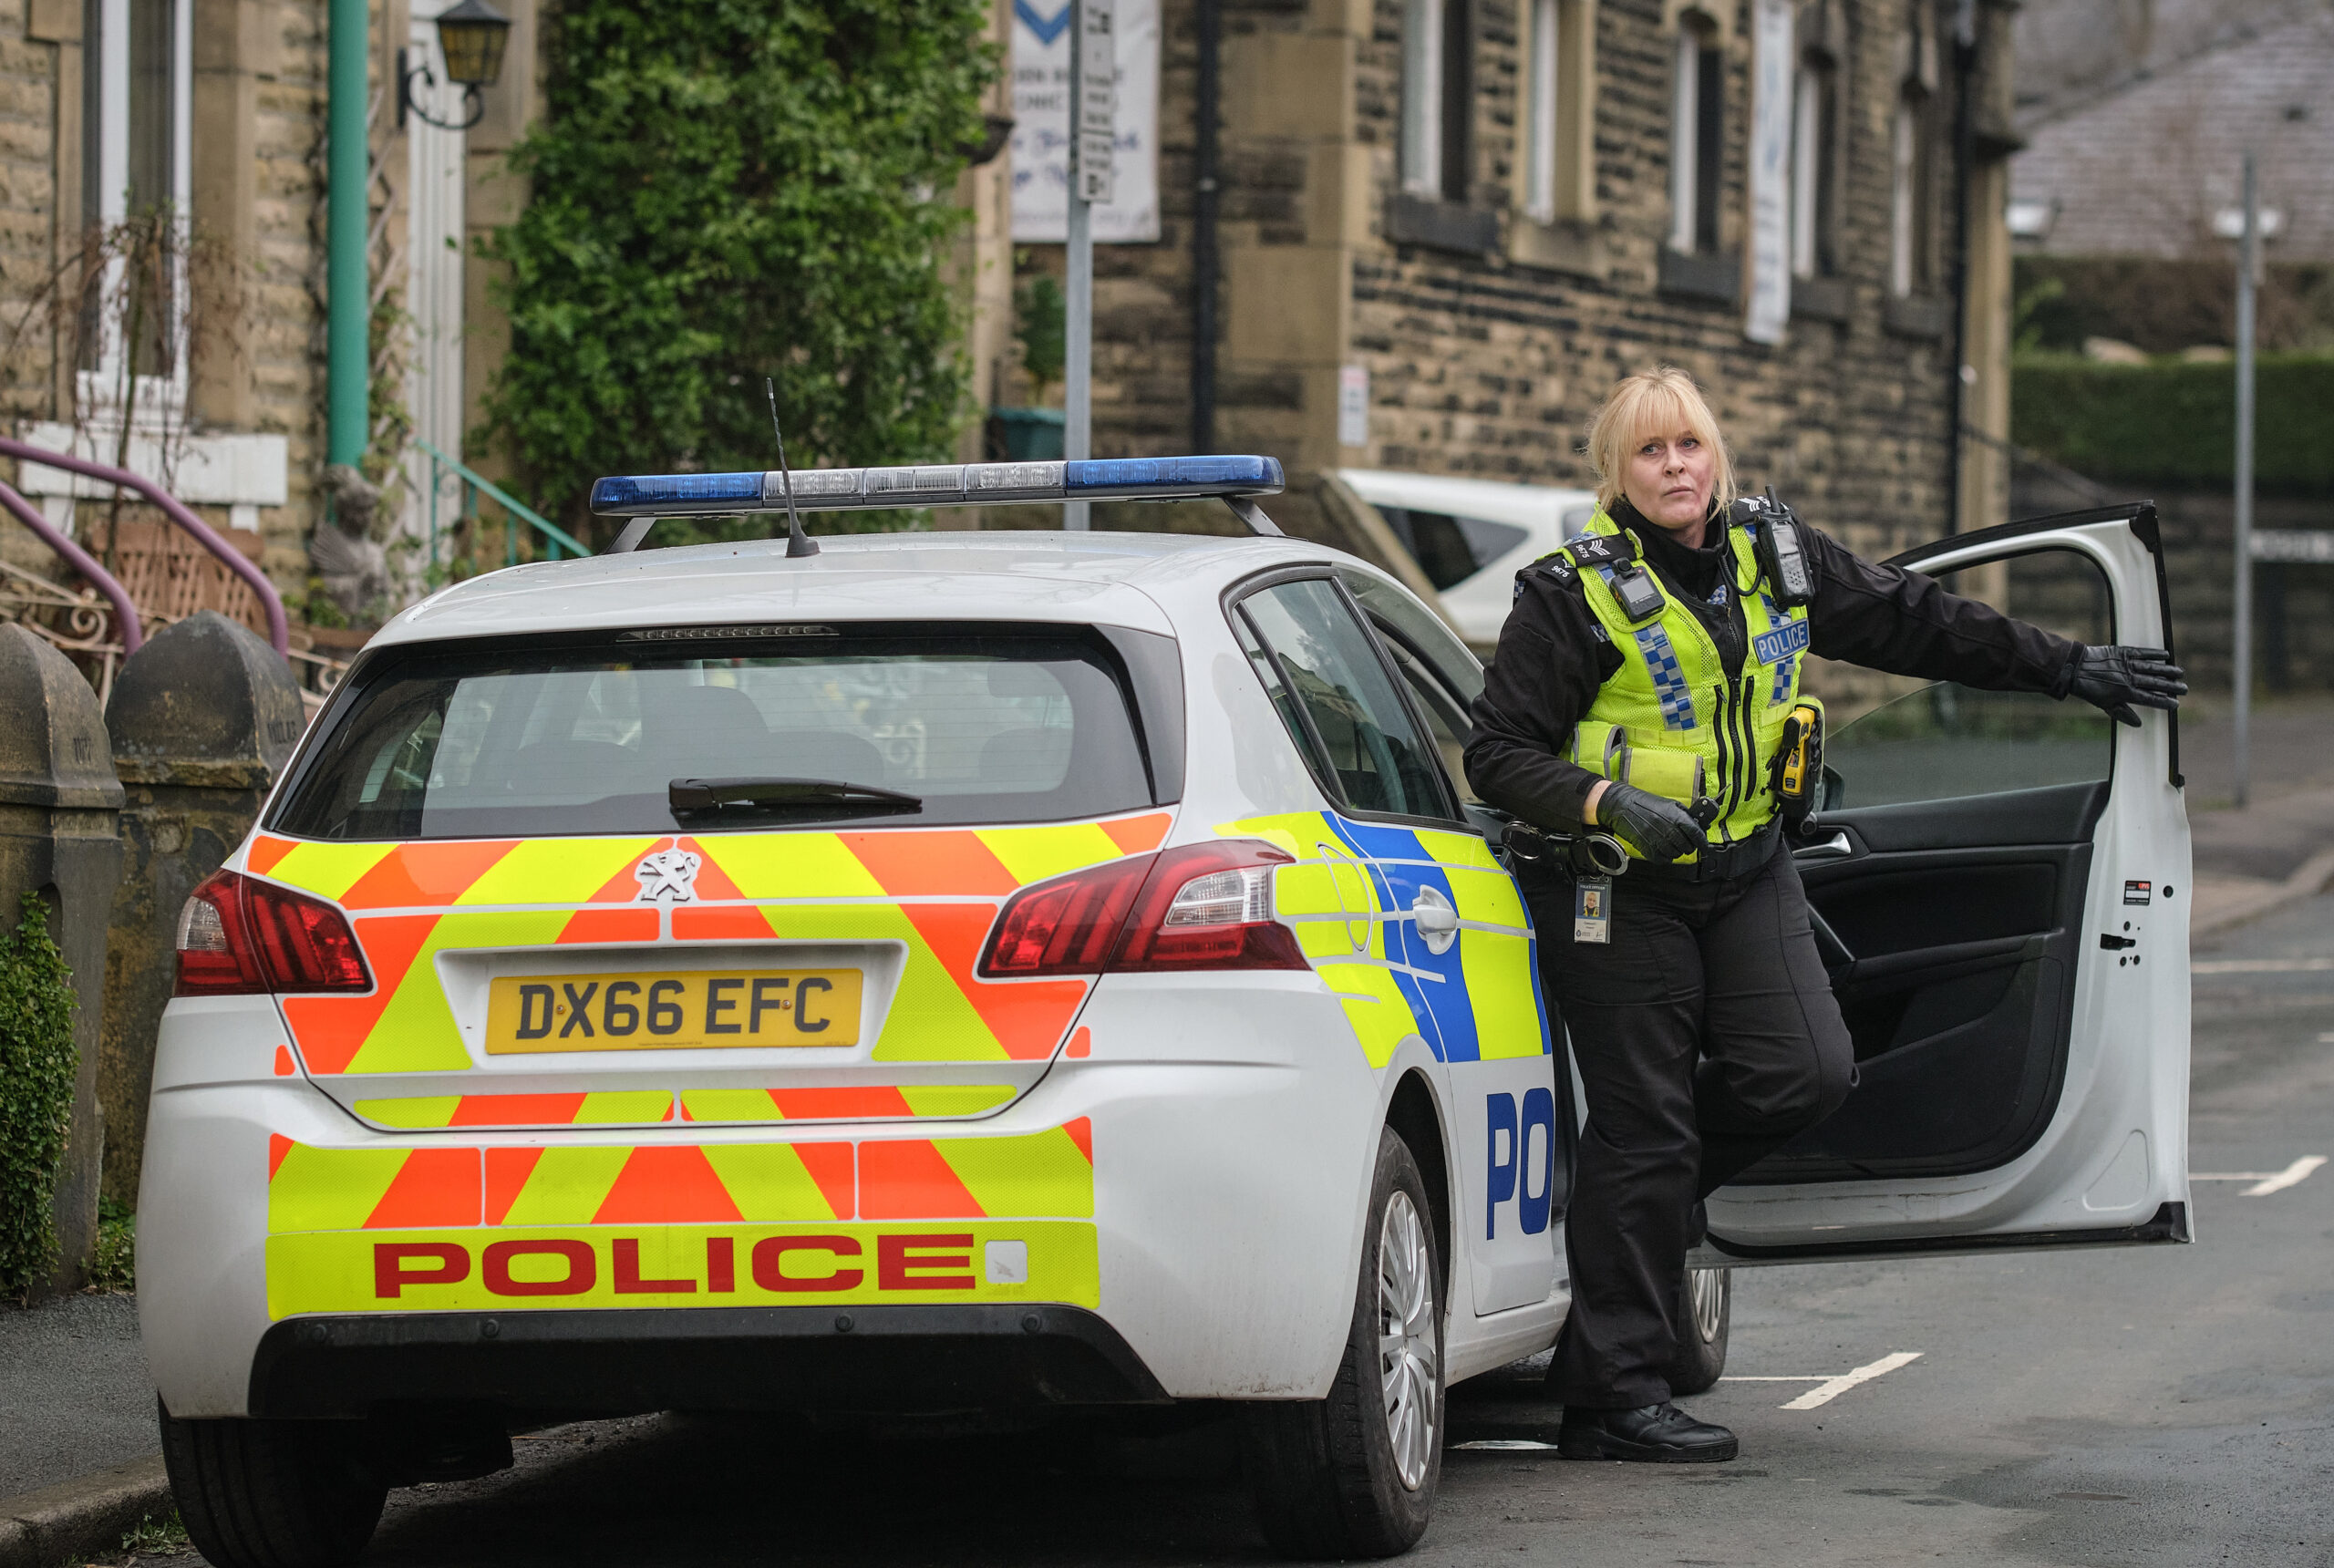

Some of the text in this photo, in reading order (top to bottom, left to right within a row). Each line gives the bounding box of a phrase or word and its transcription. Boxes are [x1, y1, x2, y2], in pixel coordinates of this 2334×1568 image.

[1551, 565, 1570, 577] 9675
[1575, 544, 1590, 558] 9675
[1758, 624, 1805, 659] POLICE
[516, 977, 832, 1039] DX66 EFC
[1487, 1088, 1554, 1240] PO
[374, 1233, 976, 1298] POLICE
